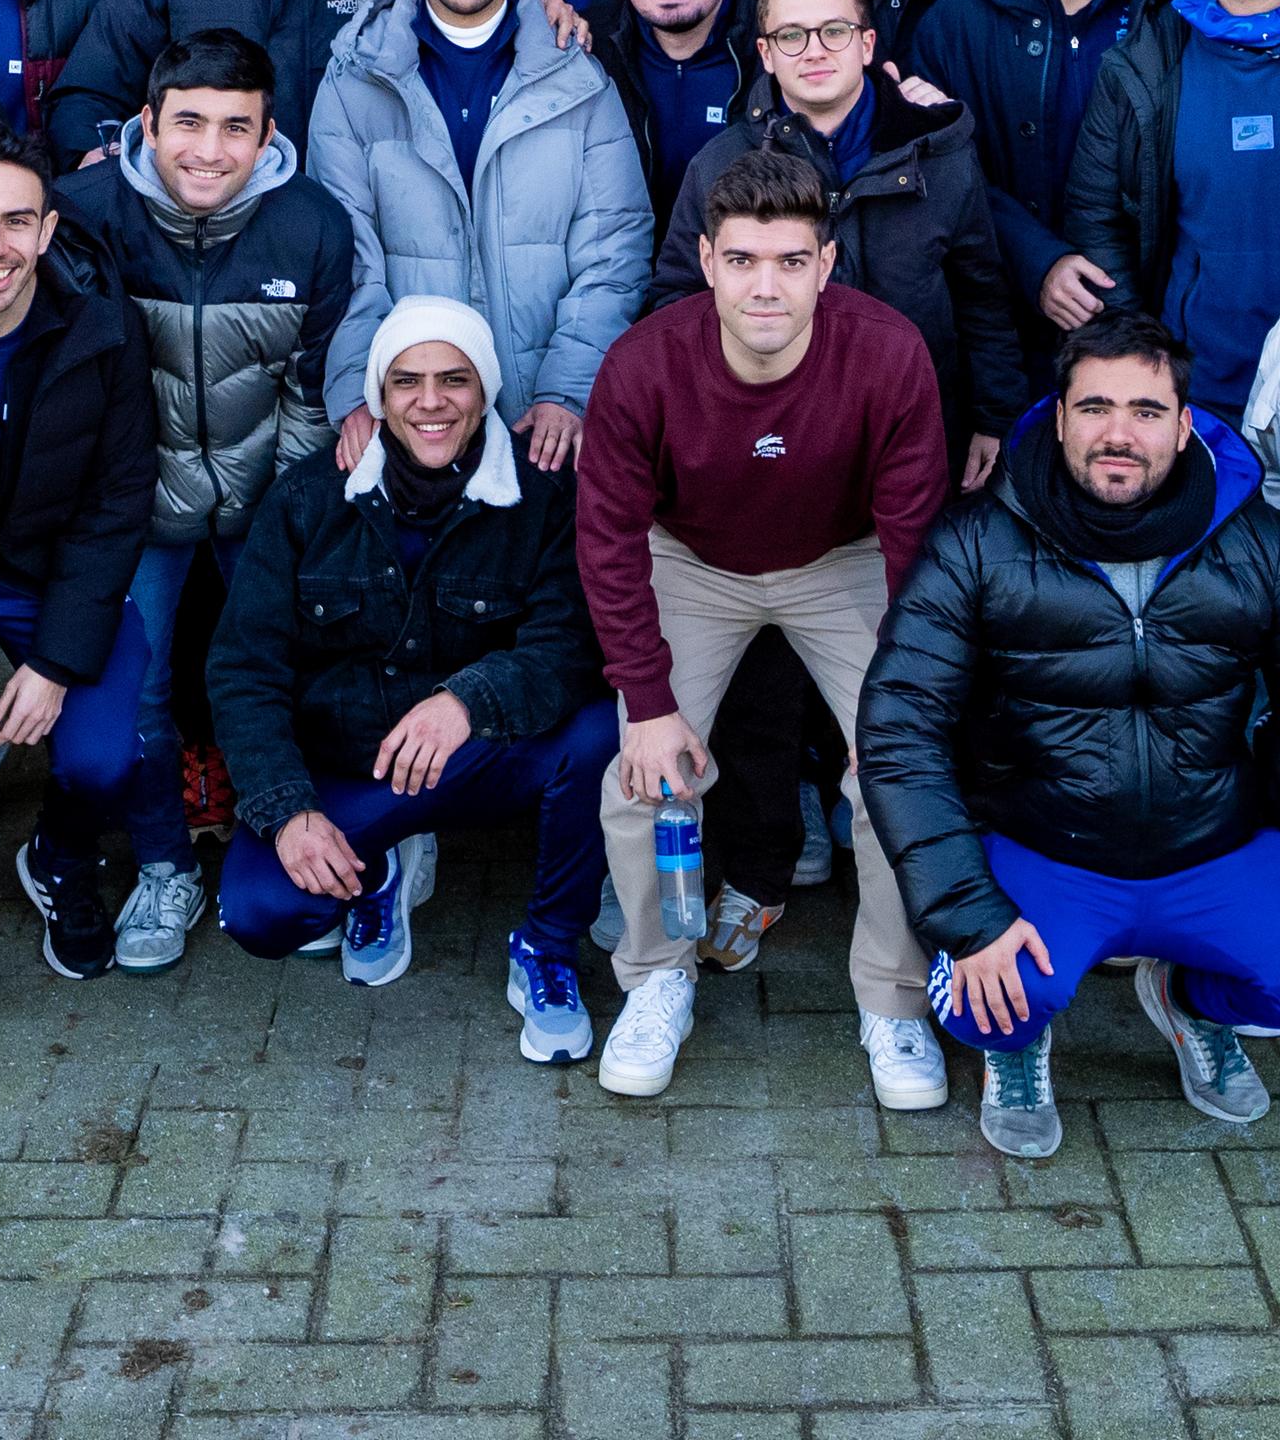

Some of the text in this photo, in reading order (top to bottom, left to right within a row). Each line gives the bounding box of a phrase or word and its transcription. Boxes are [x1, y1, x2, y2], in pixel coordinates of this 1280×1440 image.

[327, 0, 358, 8] NORTH
[271, 278, 285, 286] THE
[753, 446, 786, 457] LACOSTE
